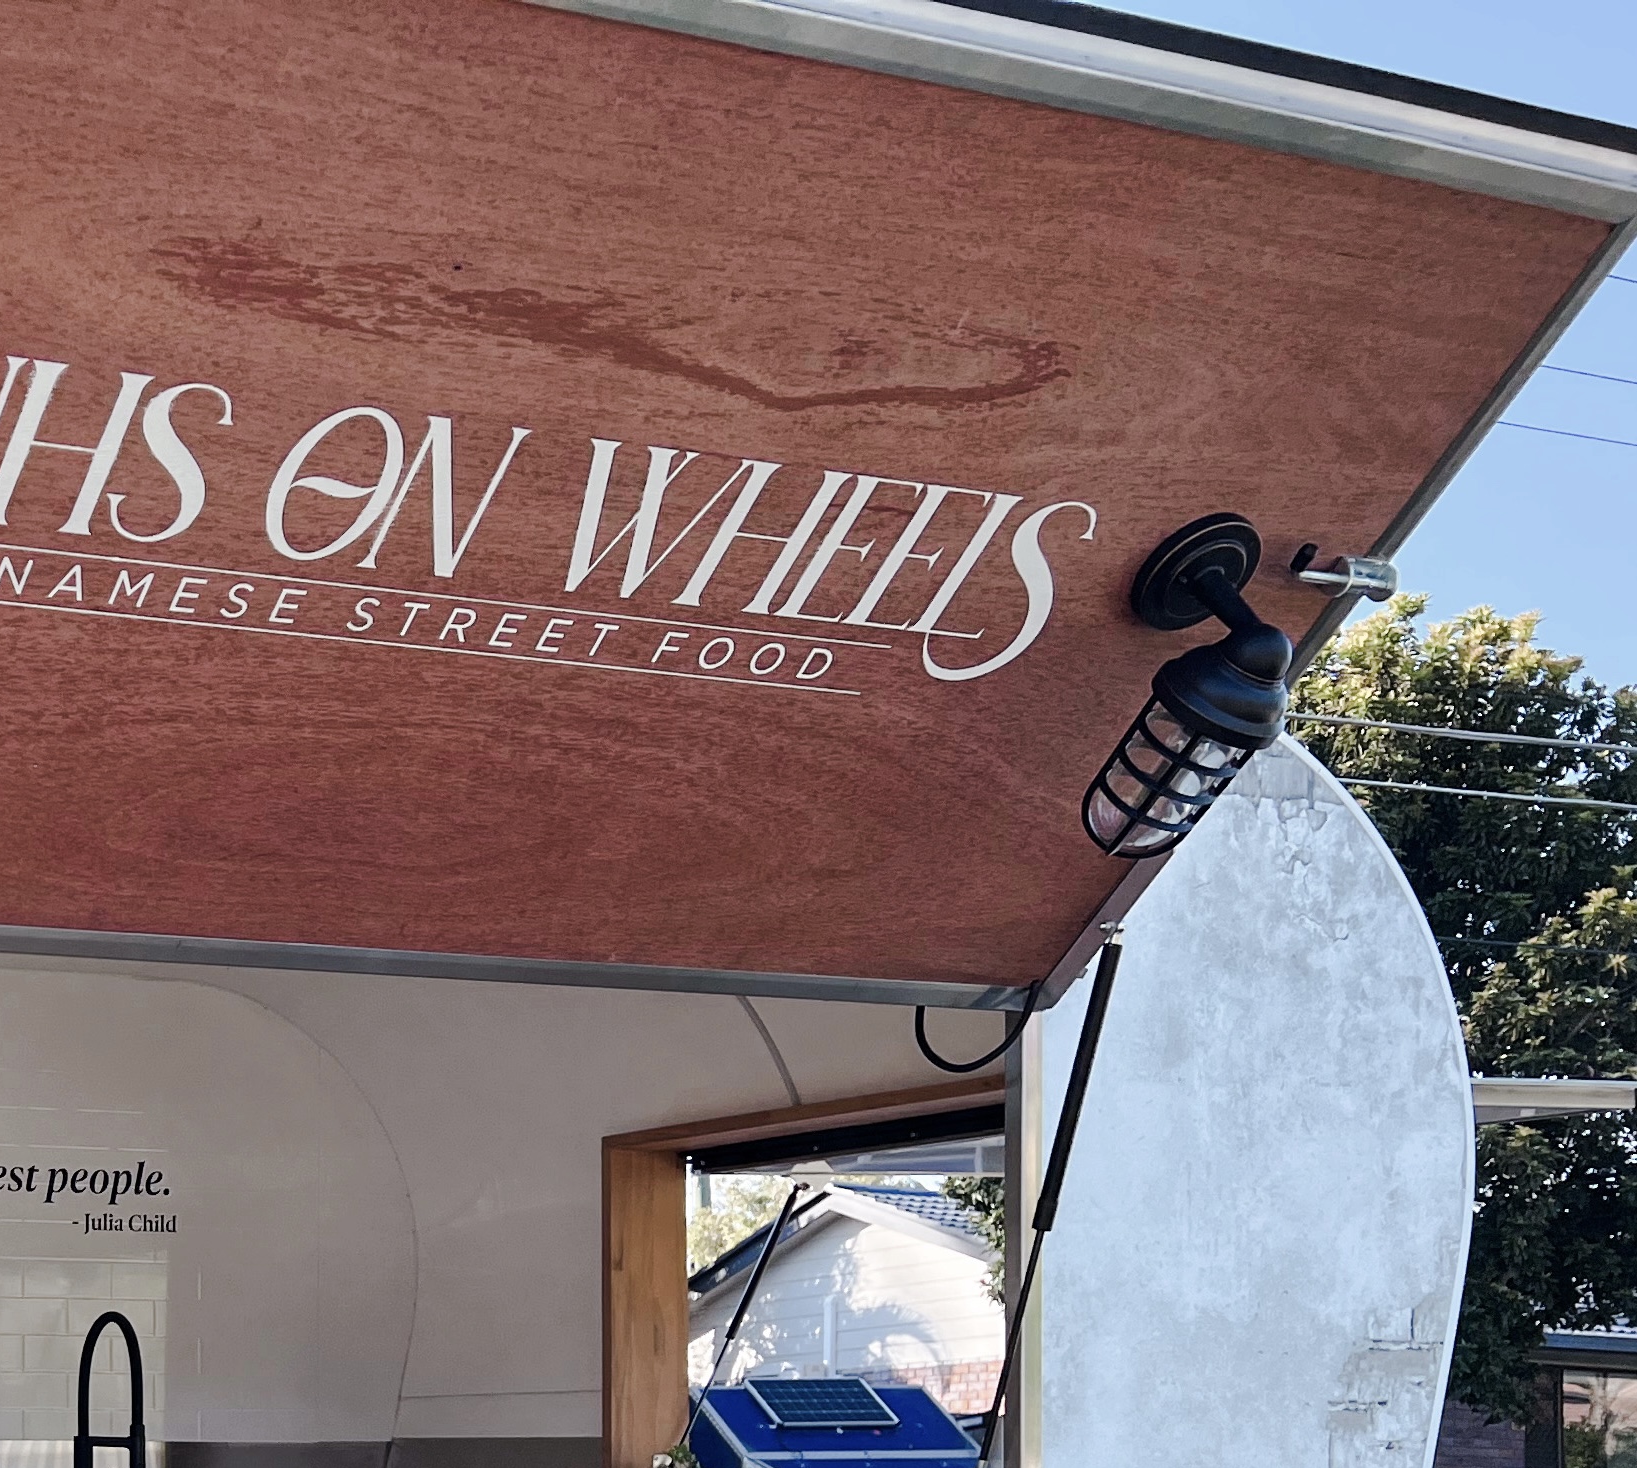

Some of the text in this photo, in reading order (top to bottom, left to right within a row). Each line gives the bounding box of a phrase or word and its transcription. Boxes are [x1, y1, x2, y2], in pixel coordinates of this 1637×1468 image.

[265, 406, 532, 578] ON
[564, 438, 1097, 681] WHEELS
[346, 597, 620, 656] STREET
[651, 631, 833, 679] FOOD
[42, 1160, 171, 1206] people.
[83, 1212, 124, 1235] Julia
[128, 1213, 178, 1234] Child
